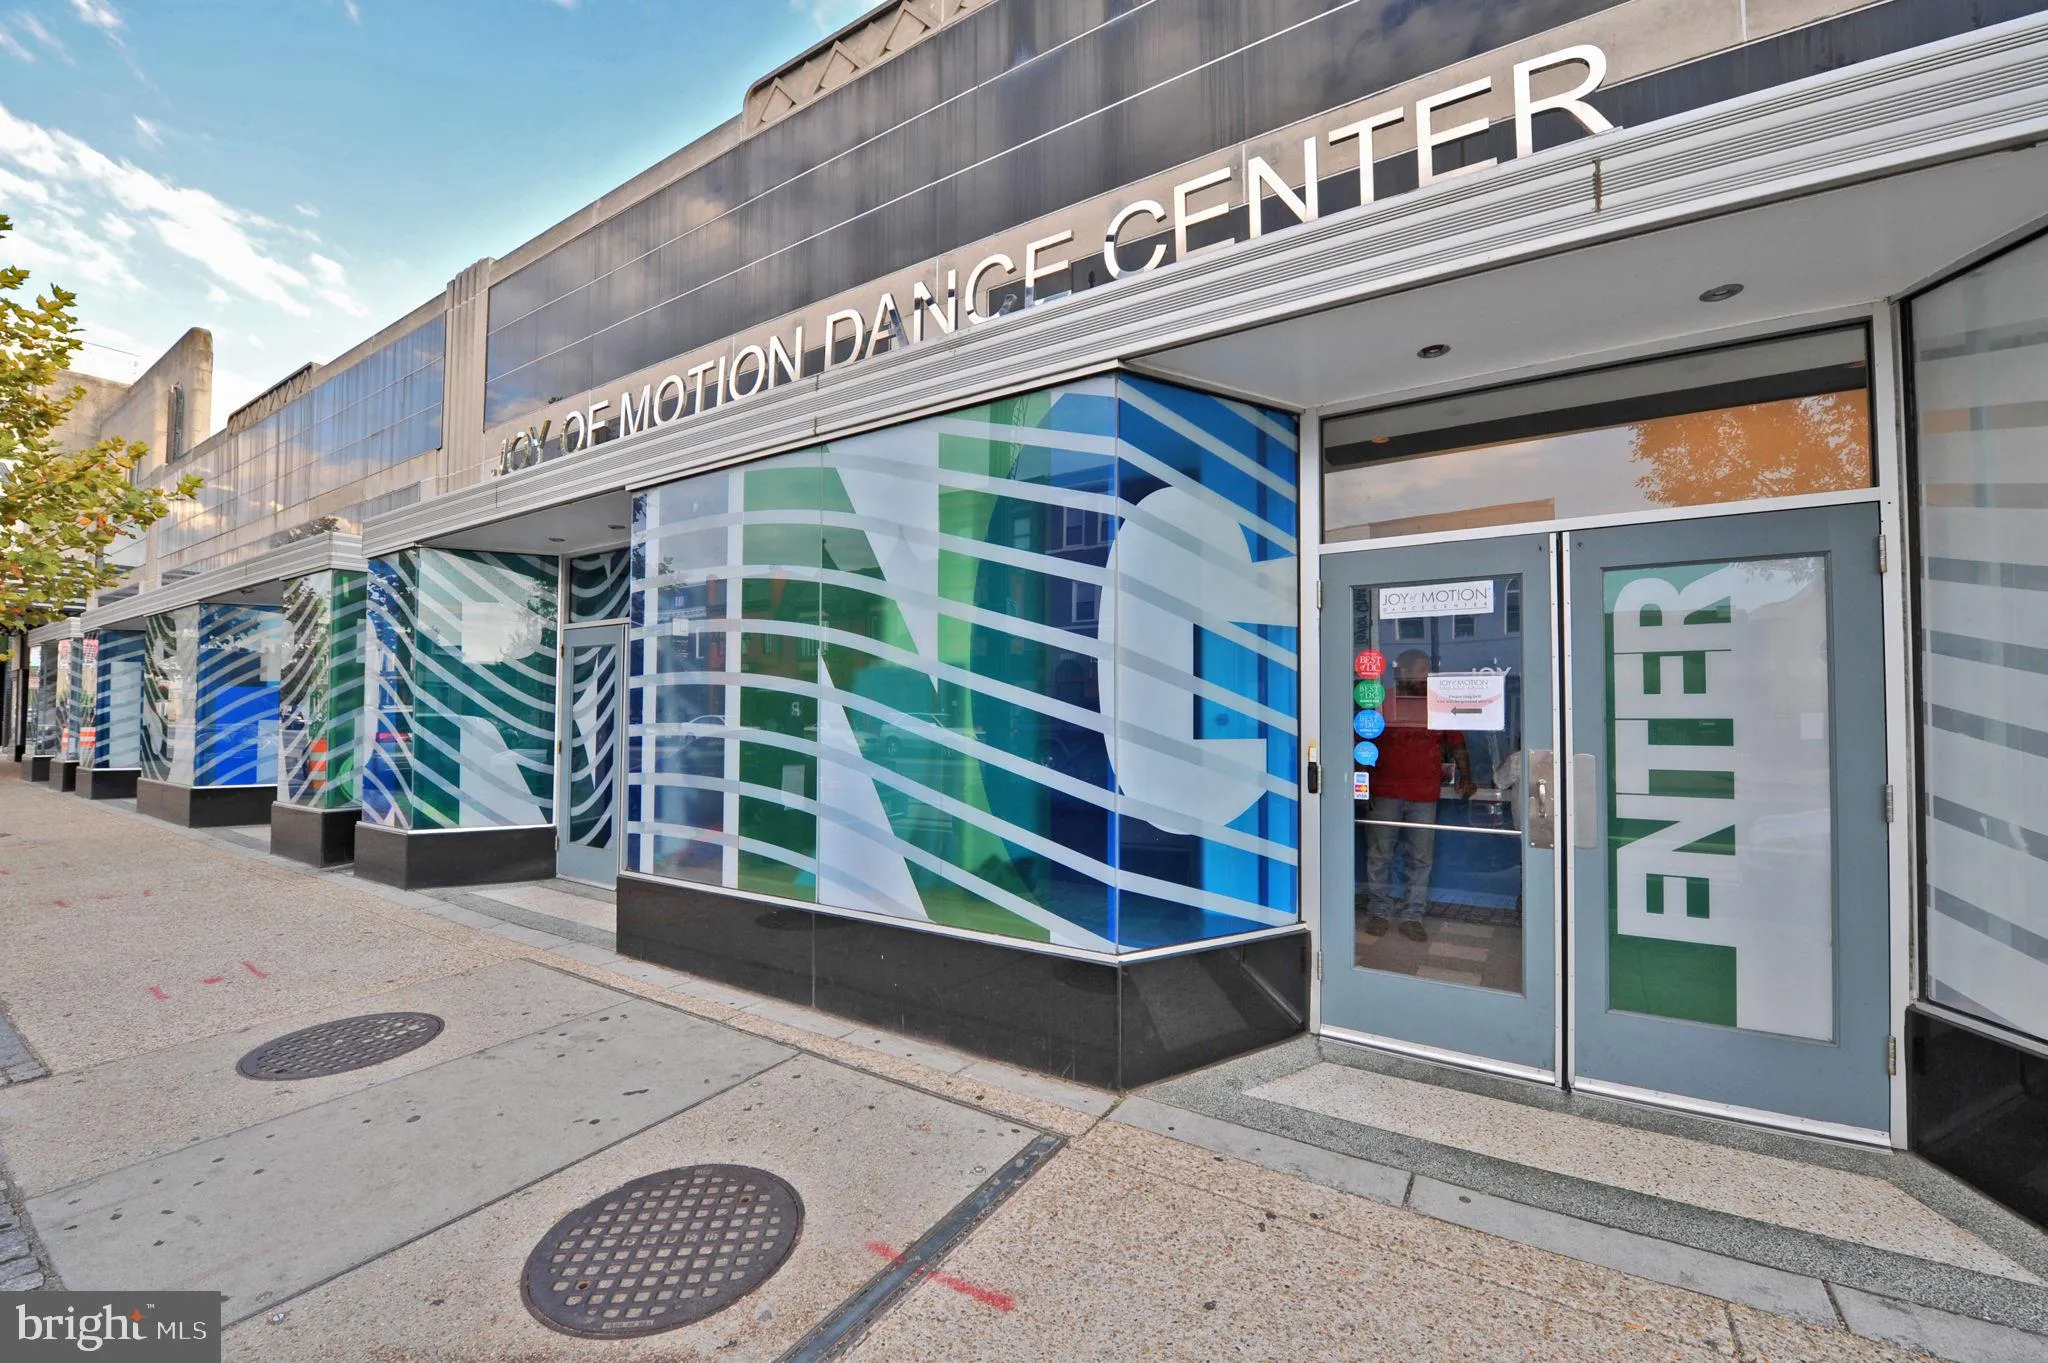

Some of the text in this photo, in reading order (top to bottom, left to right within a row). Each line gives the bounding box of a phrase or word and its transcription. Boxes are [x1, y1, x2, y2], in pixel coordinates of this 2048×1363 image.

[490, 43, 1623, 477] JOY OF MOTION DANCE CENTER
[1382, 593, 1409, 606] JOY
[1421, 587, 1487, 603] MOTION
[1383, 602, 1488, 612] DANCE CENTER
[1359, 655, 1382, 664] BEST
[1366, 663, 1381, 671] DC
[1613, 577, 1737, 947] ENTER
